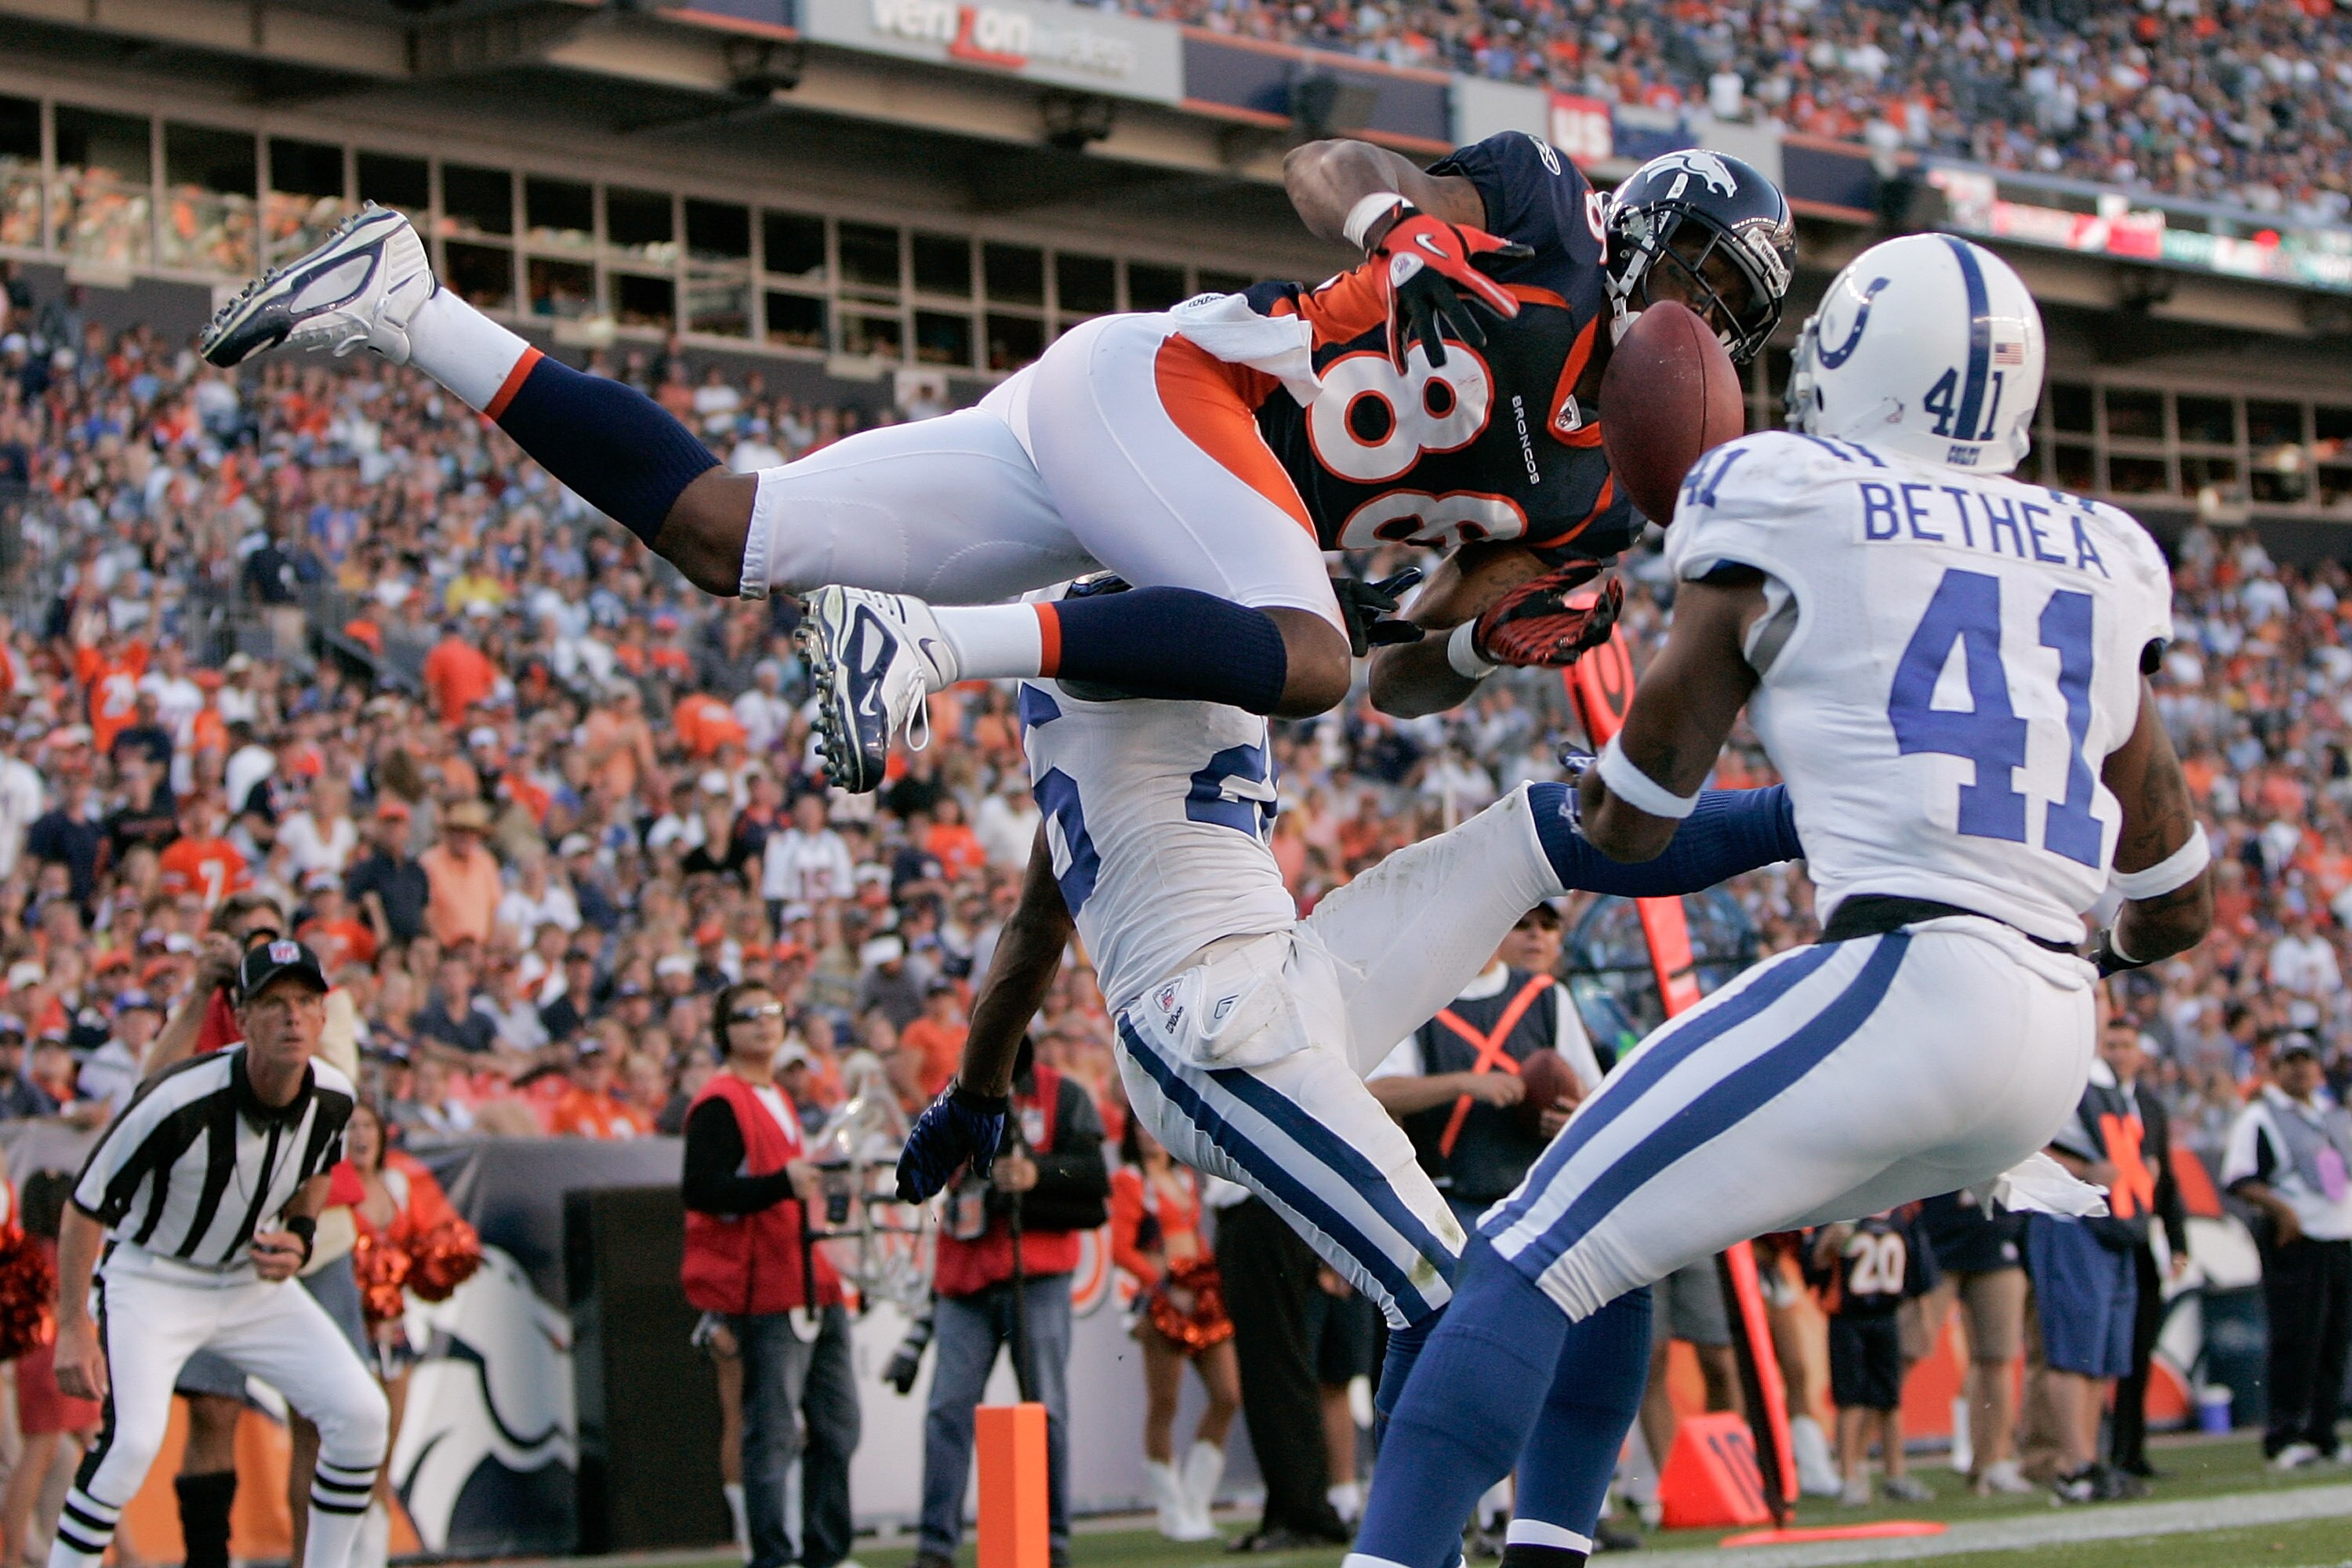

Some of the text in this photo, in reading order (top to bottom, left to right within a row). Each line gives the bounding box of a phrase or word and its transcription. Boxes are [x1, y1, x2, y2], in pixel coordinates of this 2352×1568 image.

[1512, 395, 1540, 485] BRONCOS
[1924, 366, 2004, 441] 41
[1860, 482, 2111, 579] BETHEA
[1888, 568, 2103, 870] 41
[1848, 1232, 1907, 1295] 20
